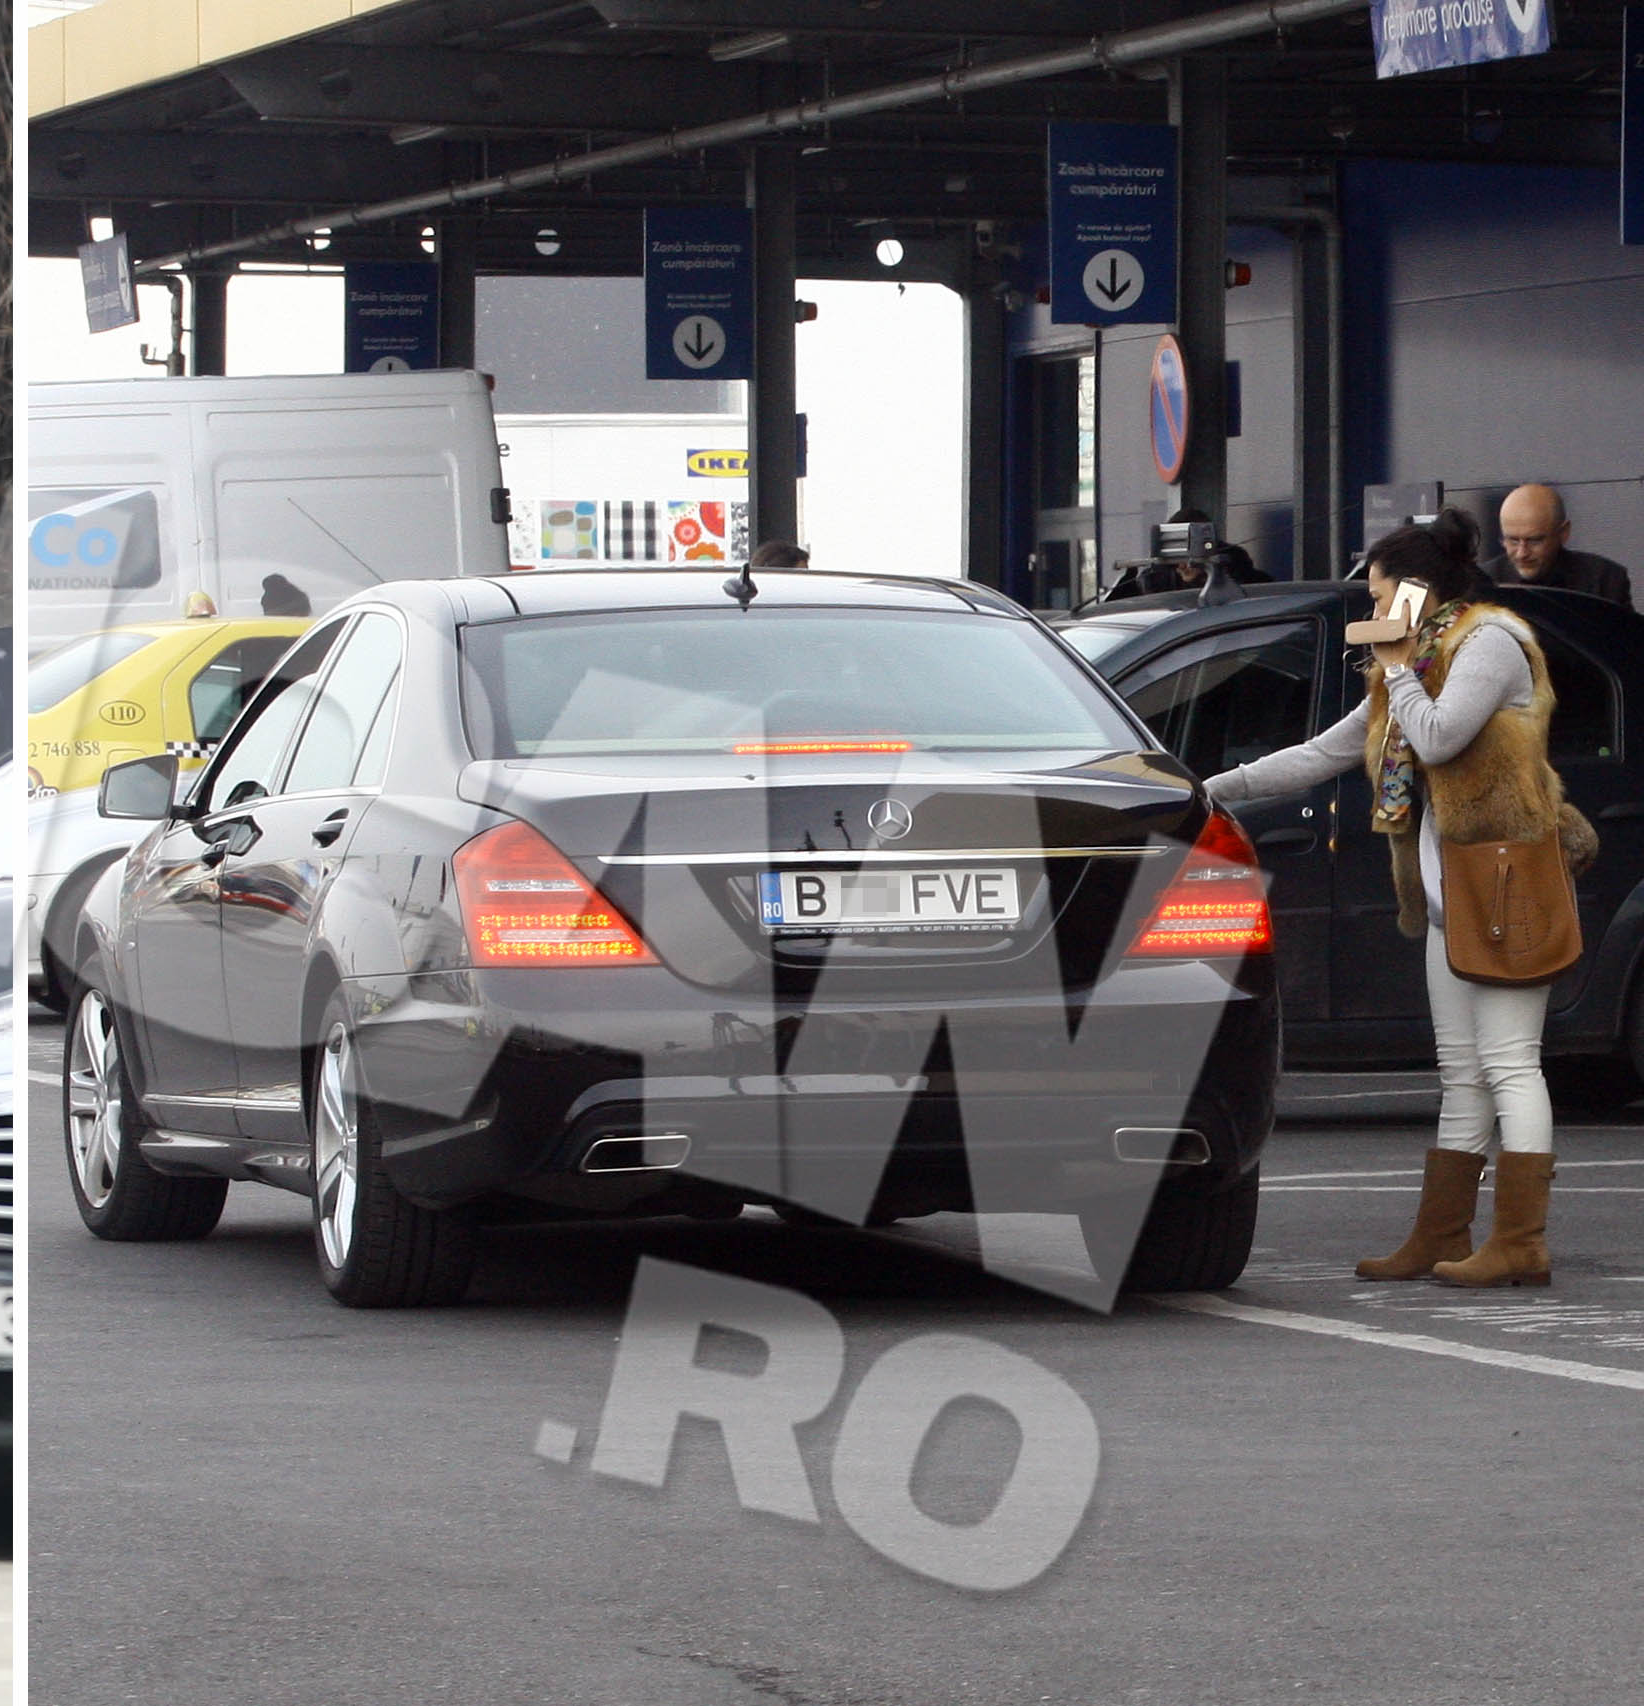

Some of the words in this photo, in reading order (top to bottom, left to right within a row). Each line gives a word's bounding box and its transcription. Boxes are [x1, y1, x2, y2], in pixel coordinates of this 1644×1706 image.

[1440, 0, 1495, 42] produse
[109, 705, 136, 721] 110
[42, 742, 70, 757] 746
[75, 741, 101, 756] 858
[794, 875, 827, 917] B
[911, 873, 1005, 914] FVE
[763, 902, 781, 917] RO
